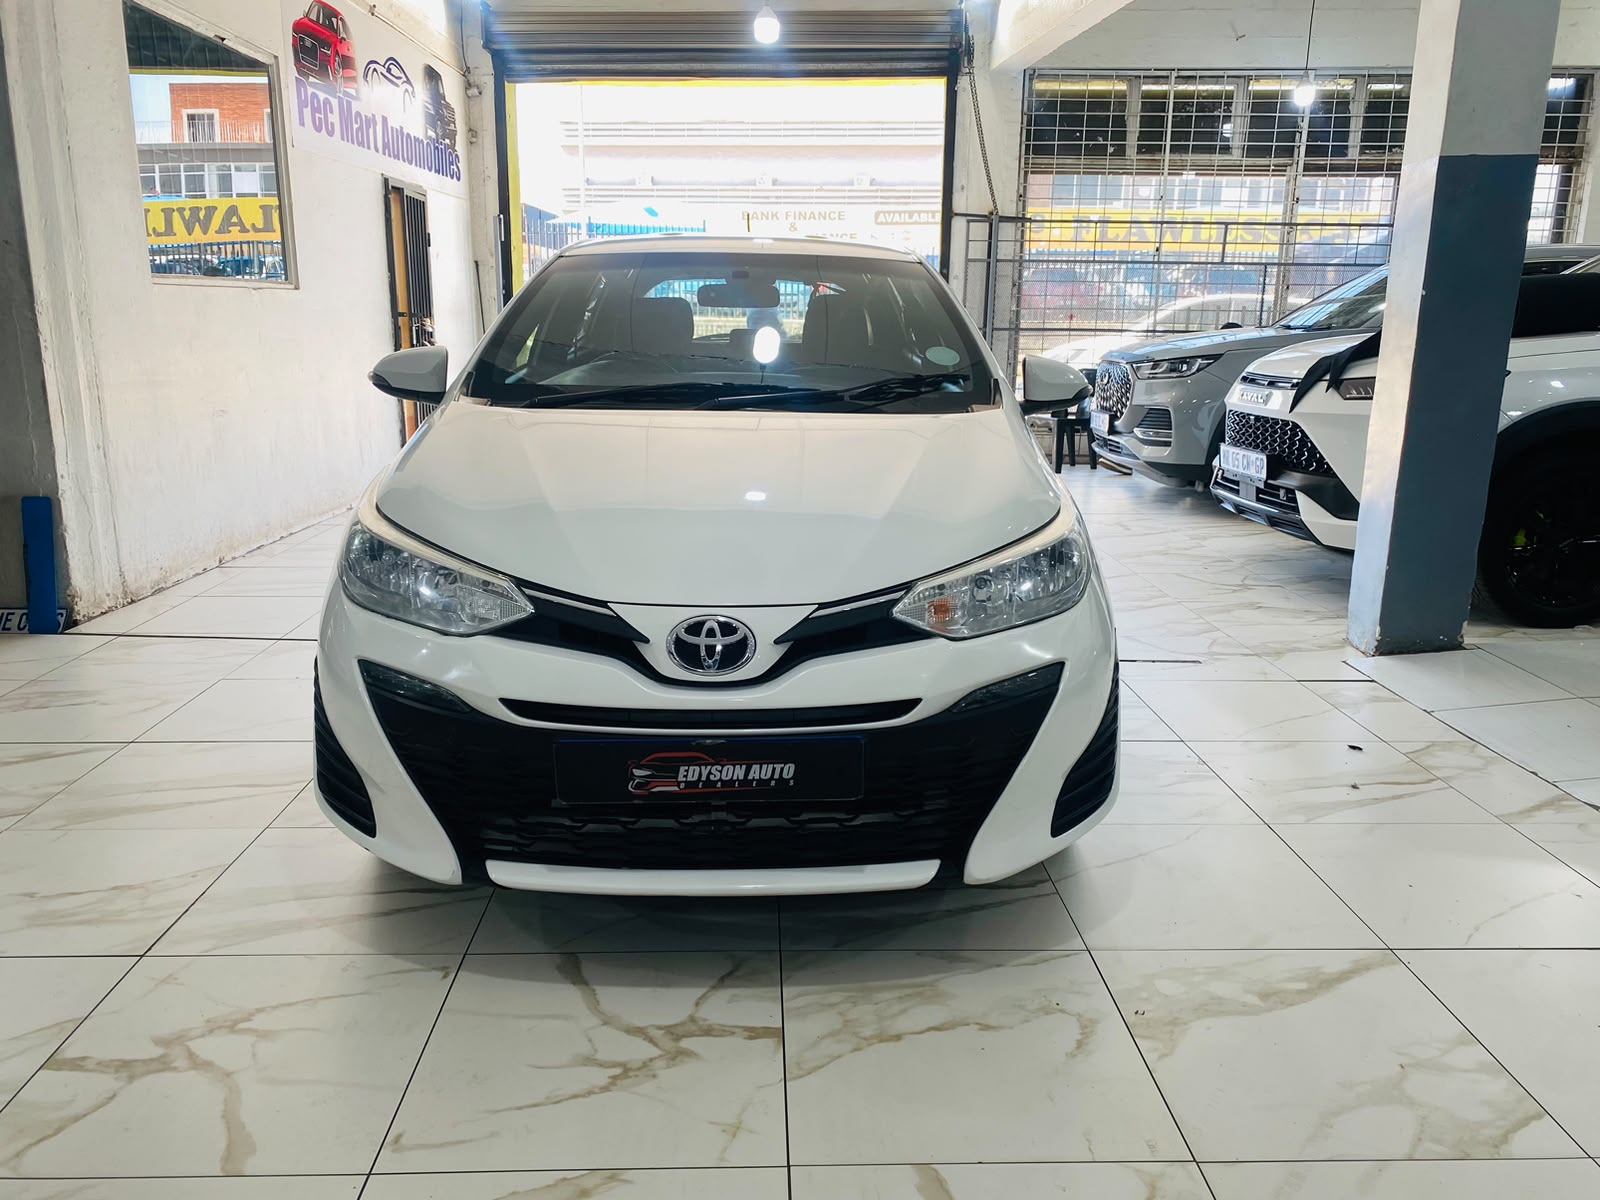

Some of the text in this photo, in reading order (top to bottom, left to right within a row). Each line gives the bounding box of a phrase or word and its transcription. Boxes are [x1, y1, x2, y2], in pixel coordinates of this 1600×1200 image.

[294, 76, 461, 182] Pec Mart Automobiles
[741, 211, 846, 221] BANK FINANCE
[788, 222, 798, 232] &
[1254, 457, 1265, 475] GP
[677, 763, 796, 782] EDYSON AUTO
